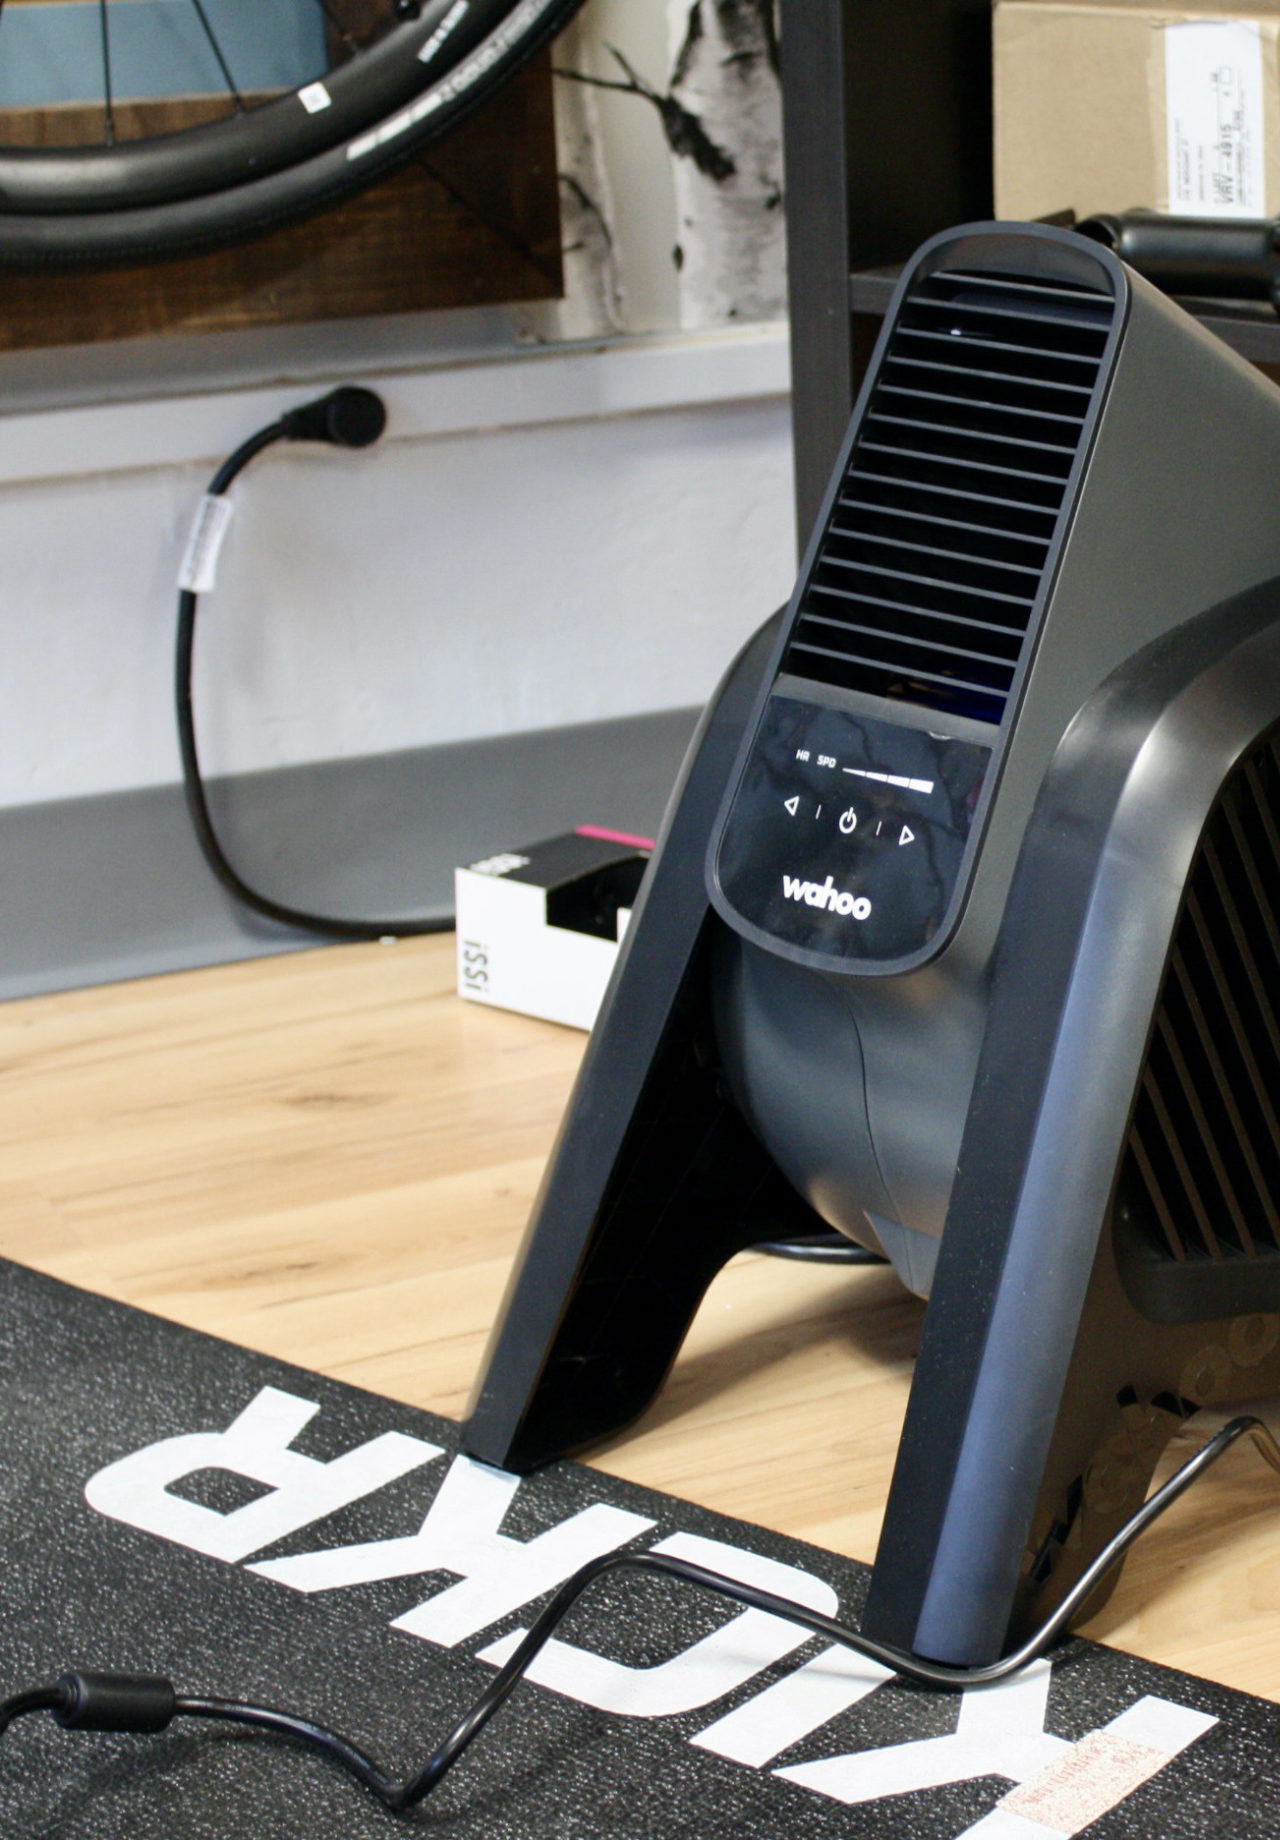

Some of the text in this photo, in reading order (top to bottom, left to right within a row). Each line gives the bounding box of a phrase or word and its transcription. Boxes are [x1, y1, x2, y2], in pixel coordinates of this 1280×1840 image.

[796, 749, 837, 768] HR SPD
[783, 875, 872, 921] wahoo
[84, 1385, 1219, 1840] KICKR
